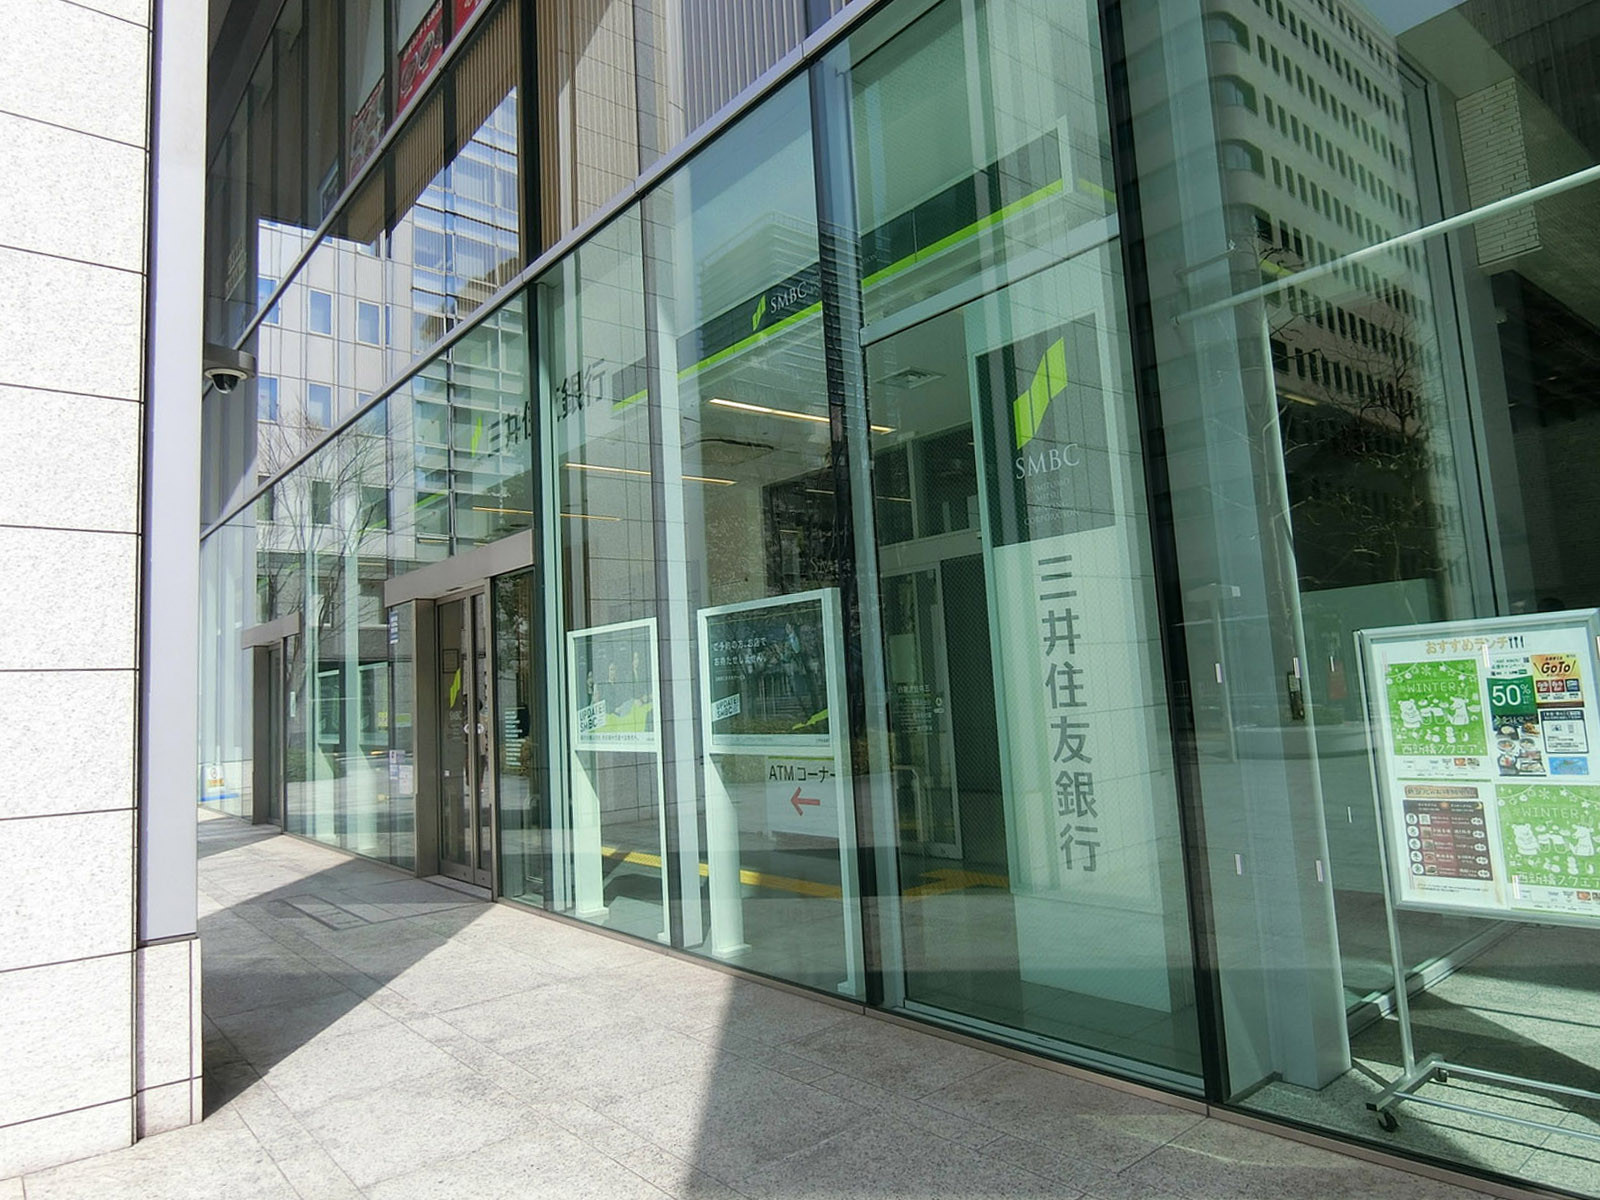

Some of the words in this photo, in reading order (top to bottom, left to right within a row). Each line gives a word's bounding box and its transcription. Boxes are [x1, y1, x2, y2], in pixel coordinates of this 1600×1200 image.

[771, 281, 807, 314] SMBC
[1015, 443, 1080, 480] SMBC
[1407, 682, 1457, 693] WINTER
[1037, 553, 1102, 874] 三井住友銀行
[1521, 807, 1579, 818] WINTER
